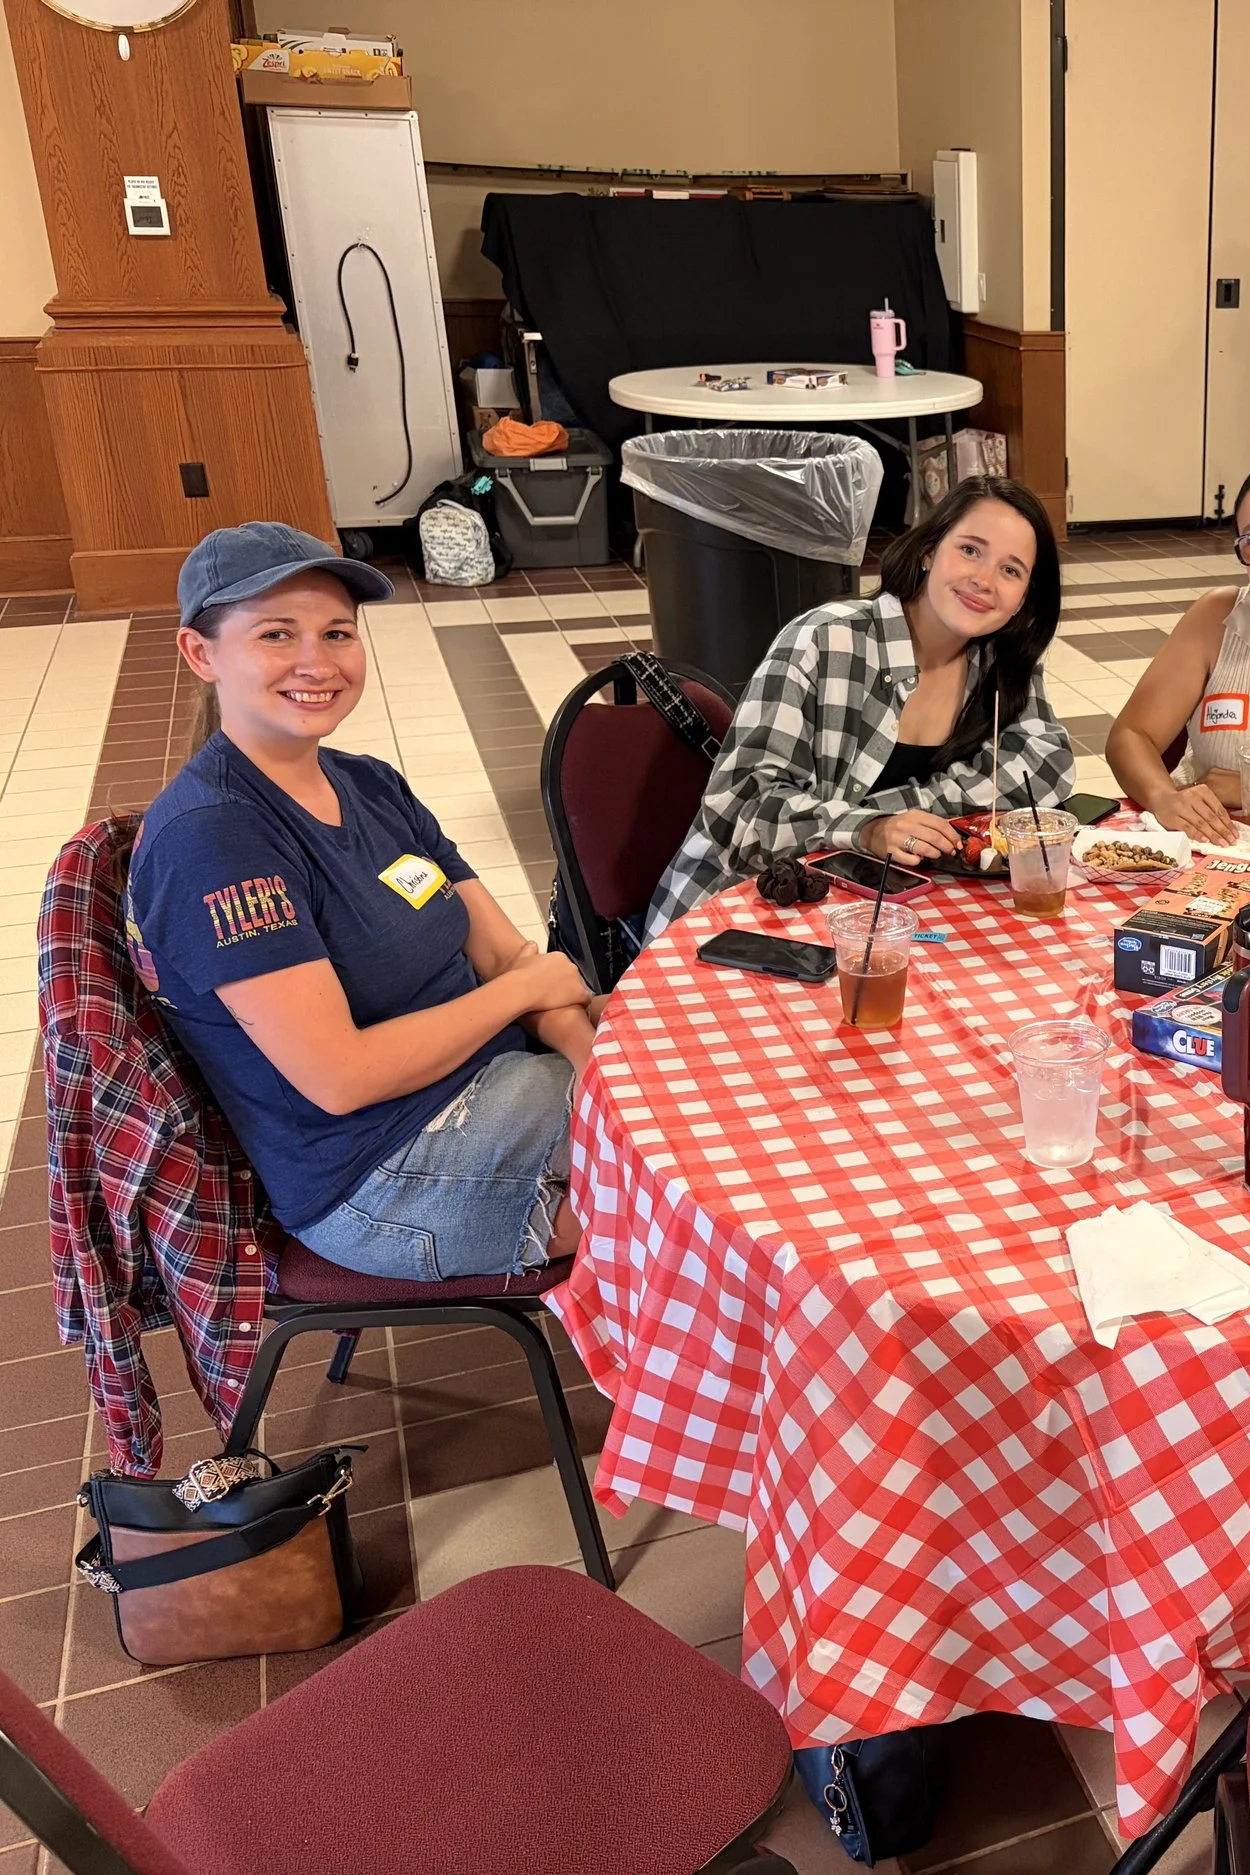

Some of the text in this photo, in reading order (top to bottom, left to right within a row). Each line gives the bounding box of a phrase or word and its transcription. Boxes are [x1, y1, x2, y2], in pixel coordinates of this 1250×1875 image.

[262, 57, 286, 69] Zespri
[203, 875, 296, 941] TYLER'S
[216, 919, 298, 949] AUSTIN, TEXAS
[1172, 1029, 1215, 1057] CLUE
